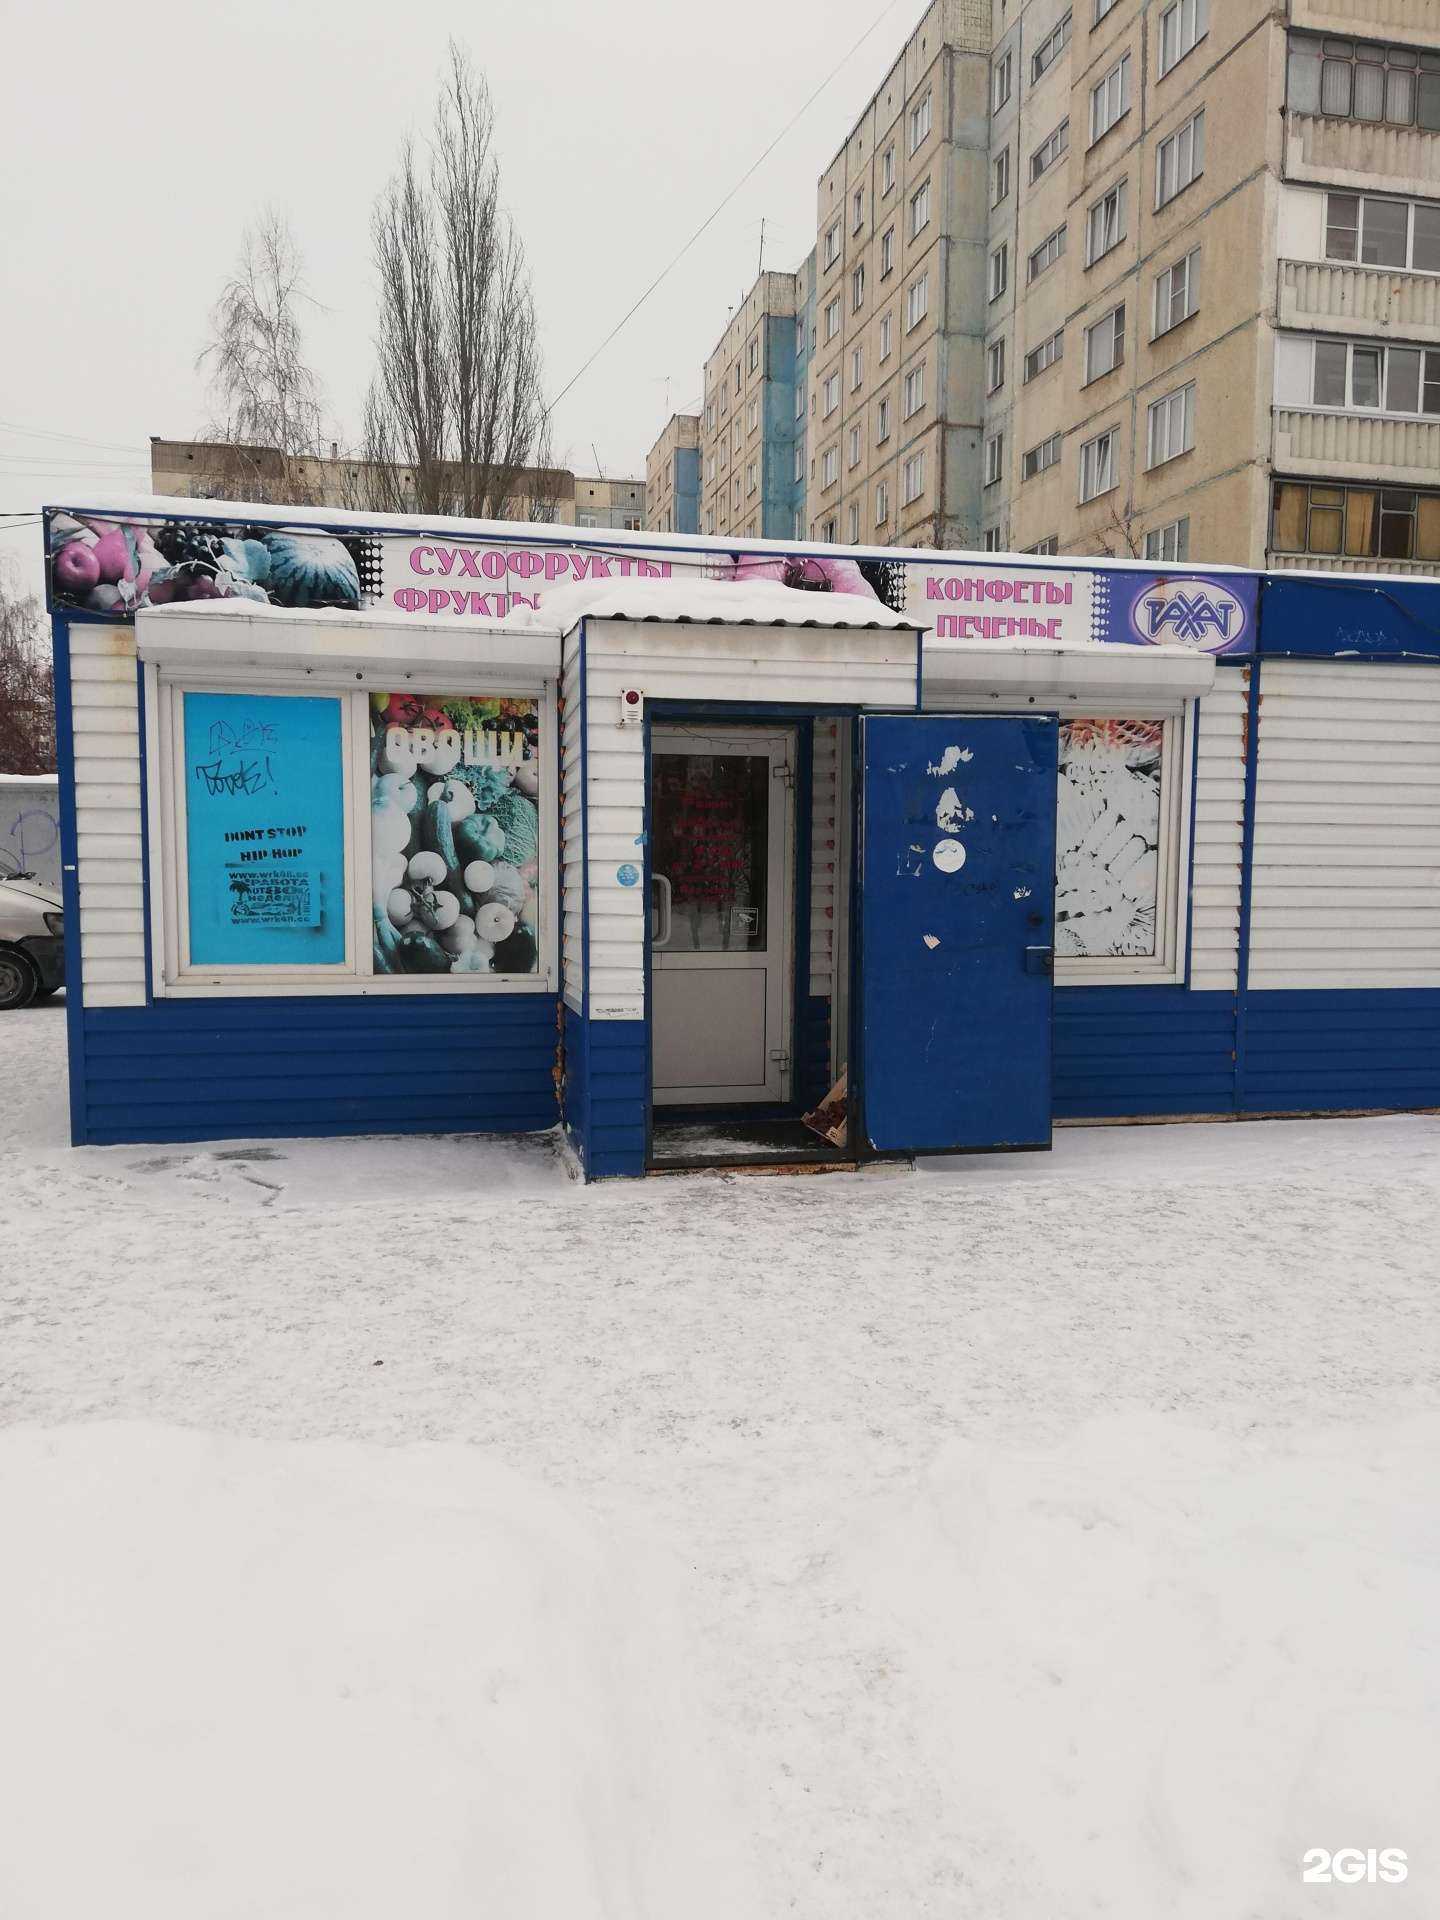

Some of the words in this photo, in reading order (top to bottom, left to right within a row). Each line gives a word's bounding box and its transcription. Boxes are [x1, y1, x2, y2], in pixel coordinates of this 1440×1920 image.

[409, 546, 672, 581] СУХОФРУКТЫ
[926, 577, 1073, 604] КОНФЕТЫ
[936, 614, 1063, 640] ПЕЧЕНЬЕ
